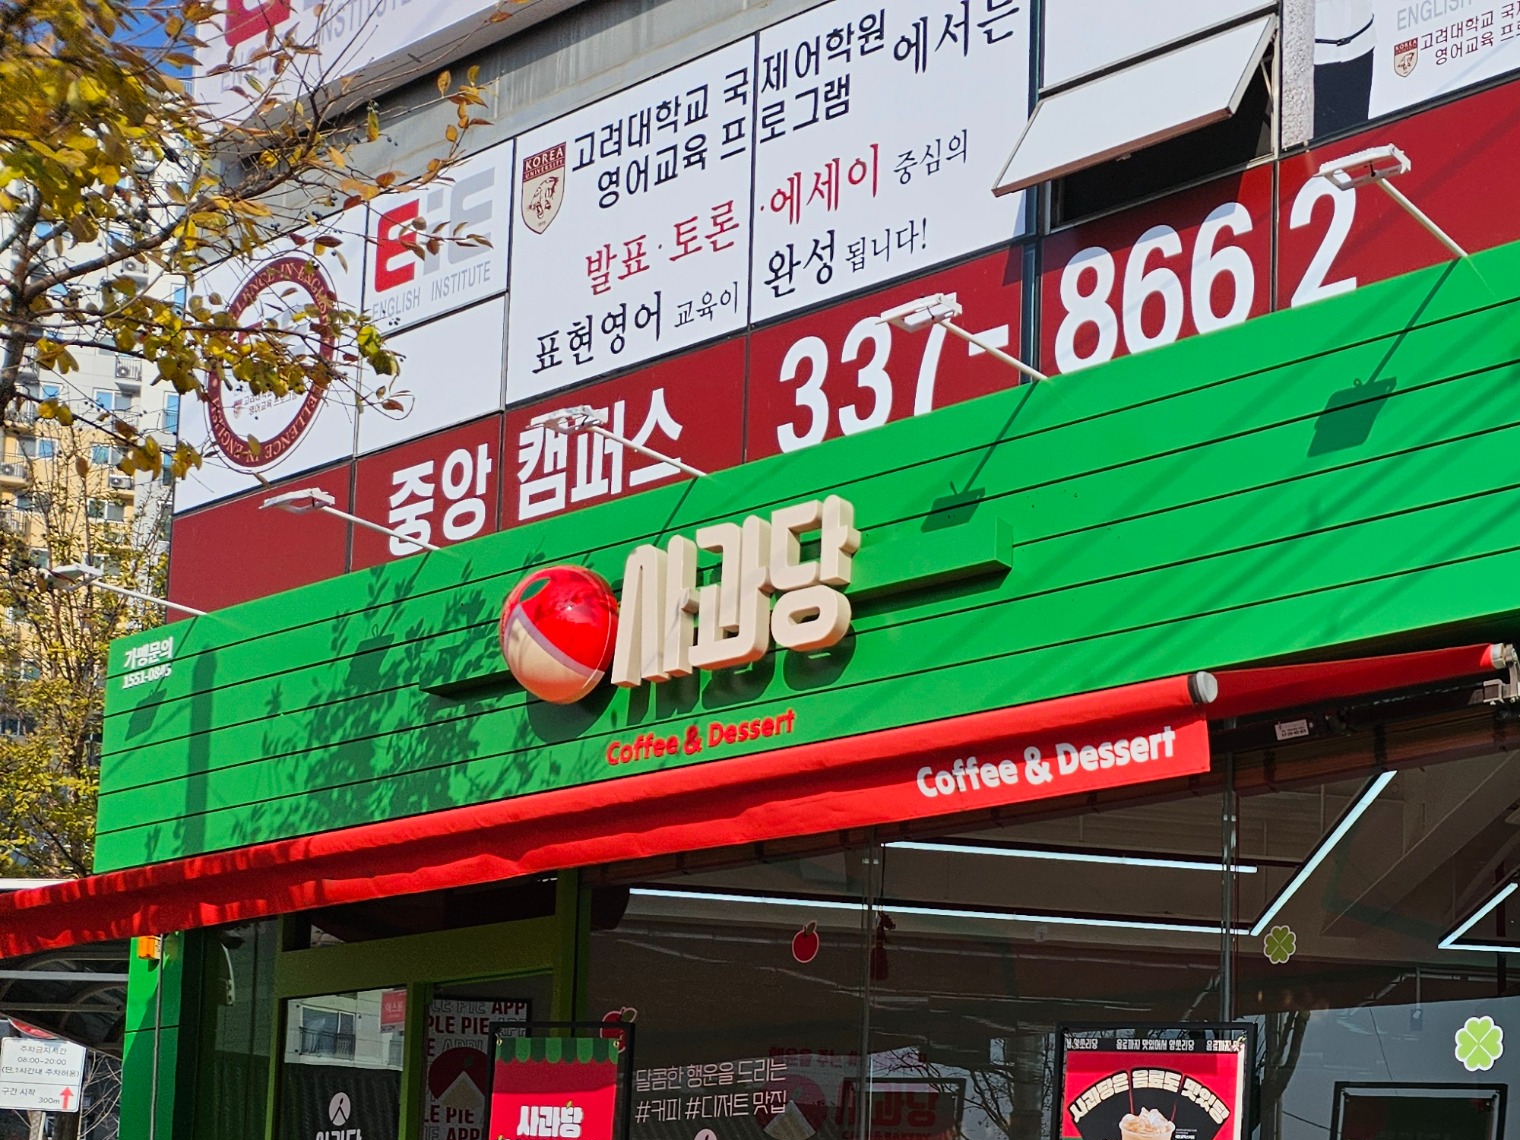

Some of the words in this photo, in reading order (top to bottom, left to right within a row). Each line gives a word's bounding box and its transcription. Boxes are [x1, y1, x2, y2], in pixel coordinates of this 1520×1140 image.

[1421, 11, 1494, 51] 고려대학교
[1435, 31, 1494, 66] 영어교육
[572, 83, 710, 172] 고려대학교
[597, 133, 707, 209] 영어교육
[720, 73, 852, 162] 프로그램
[525, 159, 564, 180] UNIVERSITY
[526, 147, 564, 172] KOREA
[892, 129, 968, 186] 중심의
[372, 287, 421, 319] ENGLISH
[431, 260, 491, 301] INSTITUTE
[531, 290, 665, 375] 표현영어
[673, 281, 740, 330] 교육이
[762, 229, 838, 299] 완성
[845, 217, 928, 273] 됩니다!
[387, 443, 492, 558] 중앙
[517, 386, 684, 522] 캠퍼스
[610, 494, 862, 688] 사과당
[123, 636, 174, 669] 가맹문의
[606, 732, 679, 766] Coffee
[683, 725, 703, 756] &
[708, 707, 796, 747] Dessert
[916, 756, 1018, 798] Coffee
[1023, 745, 1054, 786] &
[1055, 725, 1176, 776] Dessert
[461, 1017, 490, 1035] PIE
[636, 1066, 684, 1092] 달콤한
[686, 1062, 734, 1088] 행운을
[737, 1059, 788, 1083] 드리는
[1069, 1072, 1130, 1123] 사과당은
[1132, 1069, 1182, 1093] 음료도
[1180, 1077, 1231, 1125] 맛있당
[38, 1096, 60, 1104] 300m
[517, 1106, 584, 1138] 사과당
[635, 1098, 681, 1124] #커피
[685, 1094, 749, 1120] #디저트
[753, 1090, 787, 1115] 맛집
